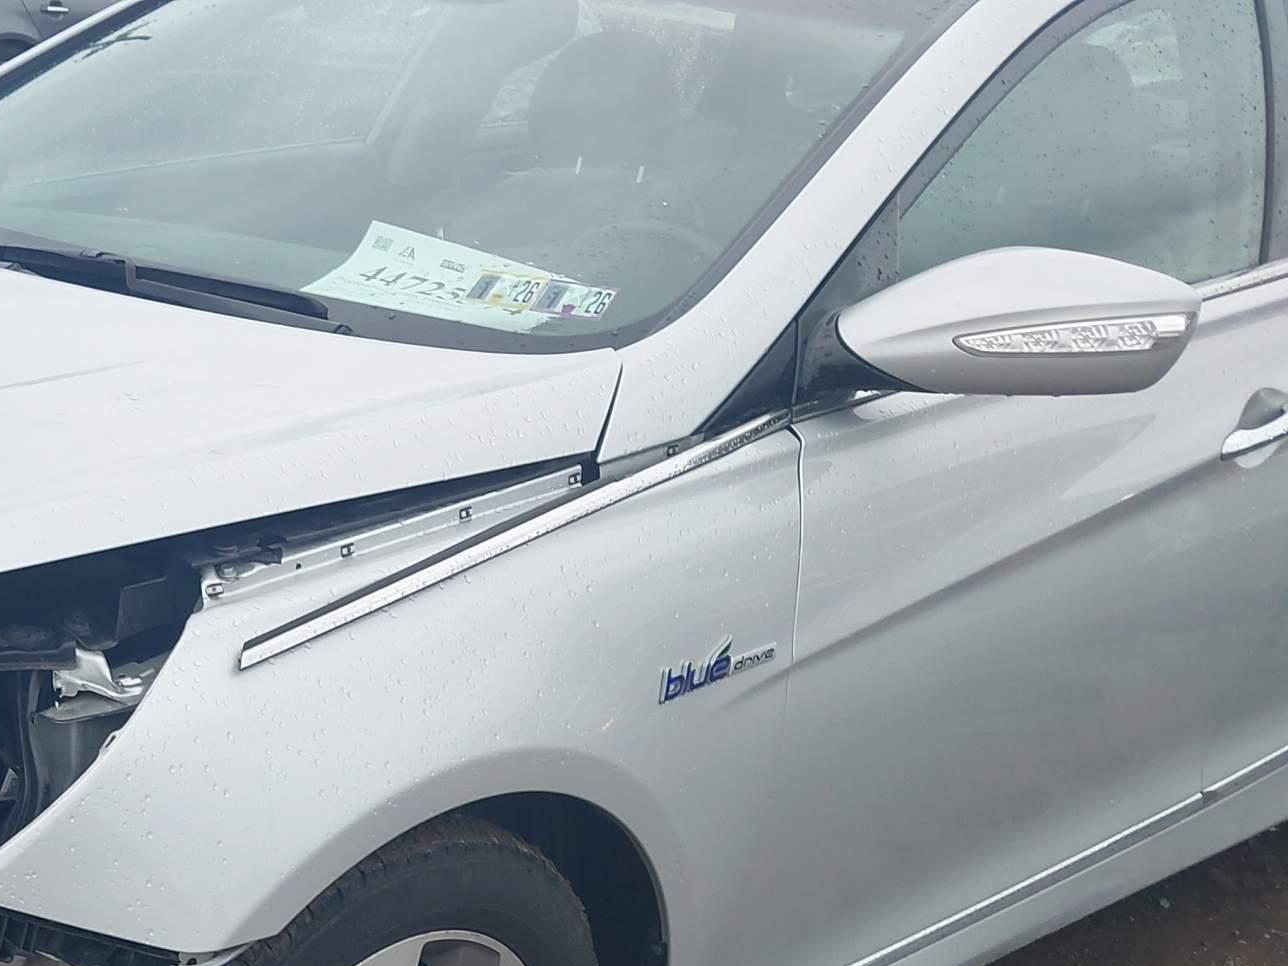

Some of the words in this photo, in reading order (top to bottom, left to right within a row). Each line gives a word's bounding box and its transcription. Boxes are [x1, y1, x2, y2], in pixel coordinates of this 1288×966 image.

[359, 266, 467, 305] 44725
[584, 291, 613, 315] 26
[659, 638, 733, 704] blue
[733, 648, 775, 672] drive
